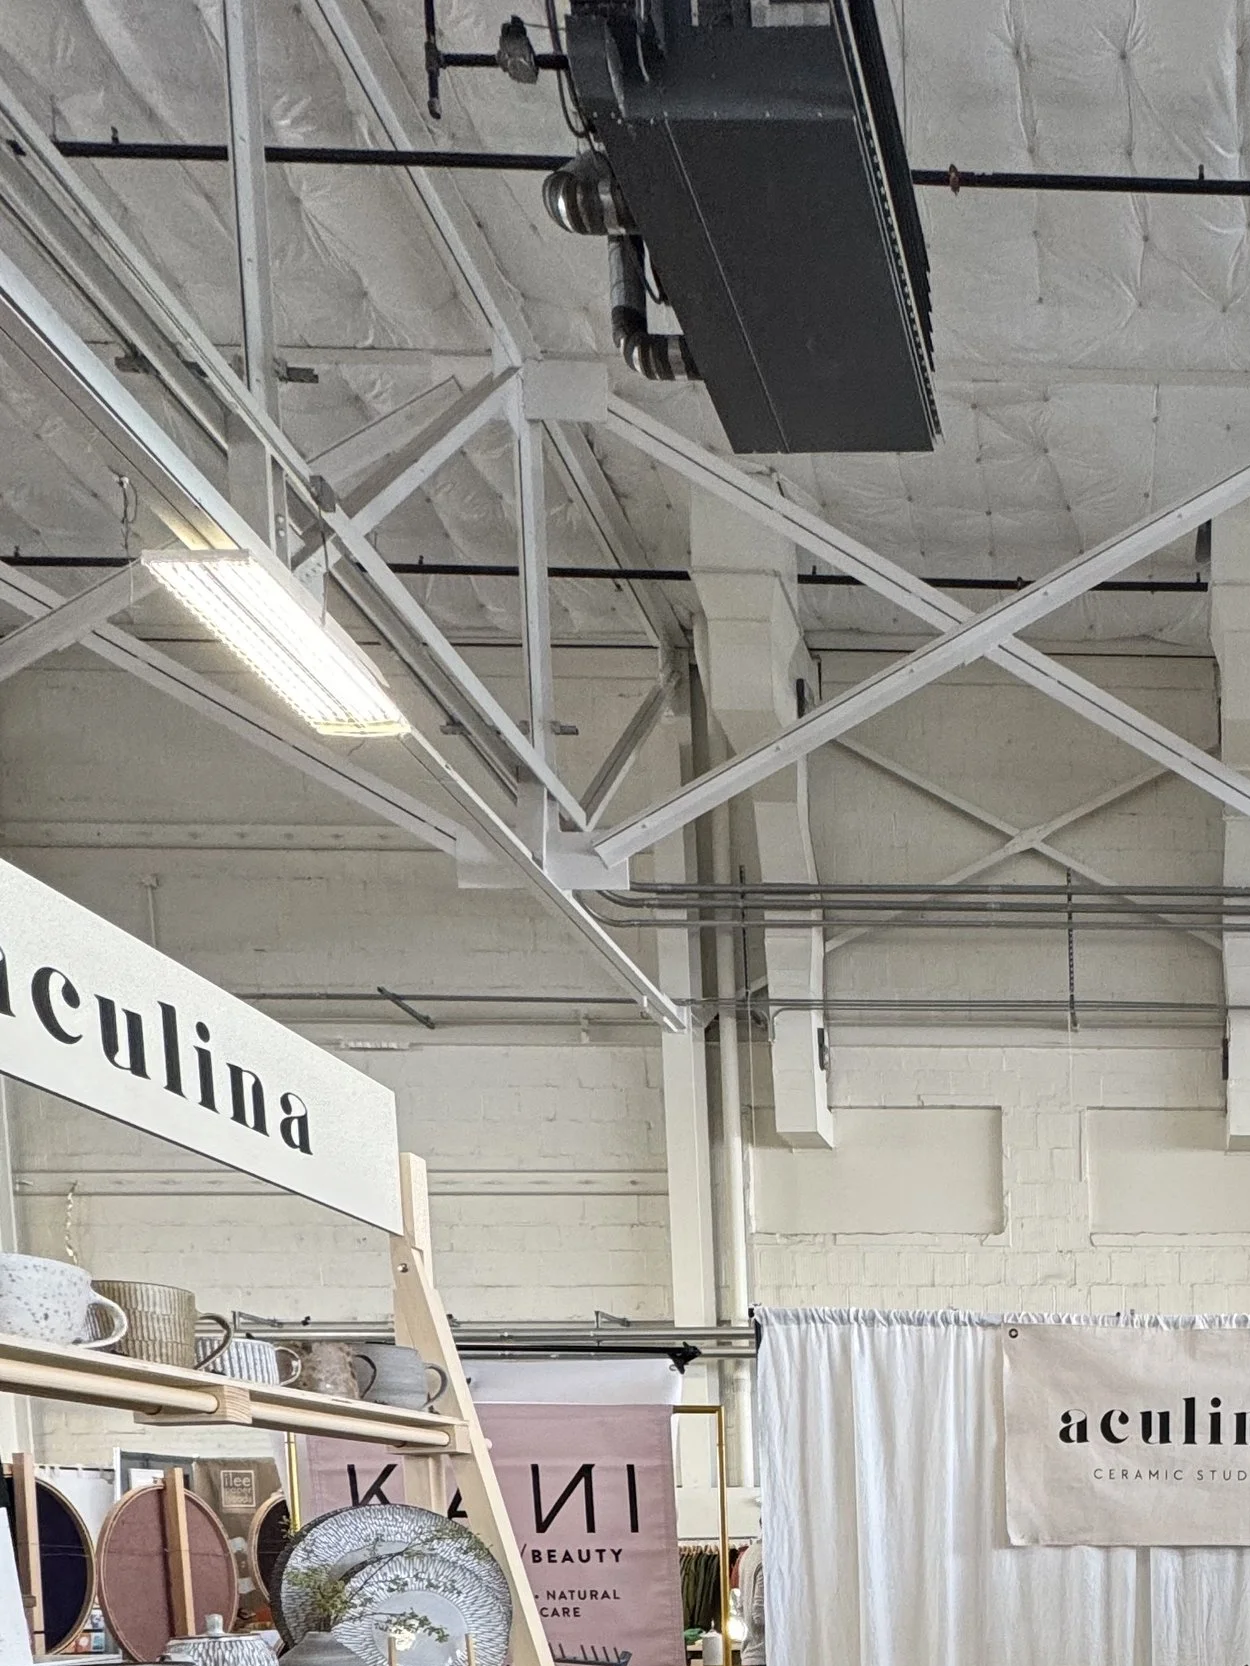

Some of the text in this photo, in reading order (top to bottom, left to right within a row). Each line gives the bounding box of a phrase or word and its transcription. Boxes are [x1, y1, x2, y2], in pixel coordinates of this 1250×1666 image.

[0, 946, 313, 1156] culina
[1093, 1468, 1184, 1482] CERAMIC
[546, 1589, 621, 1601] NATURAL
